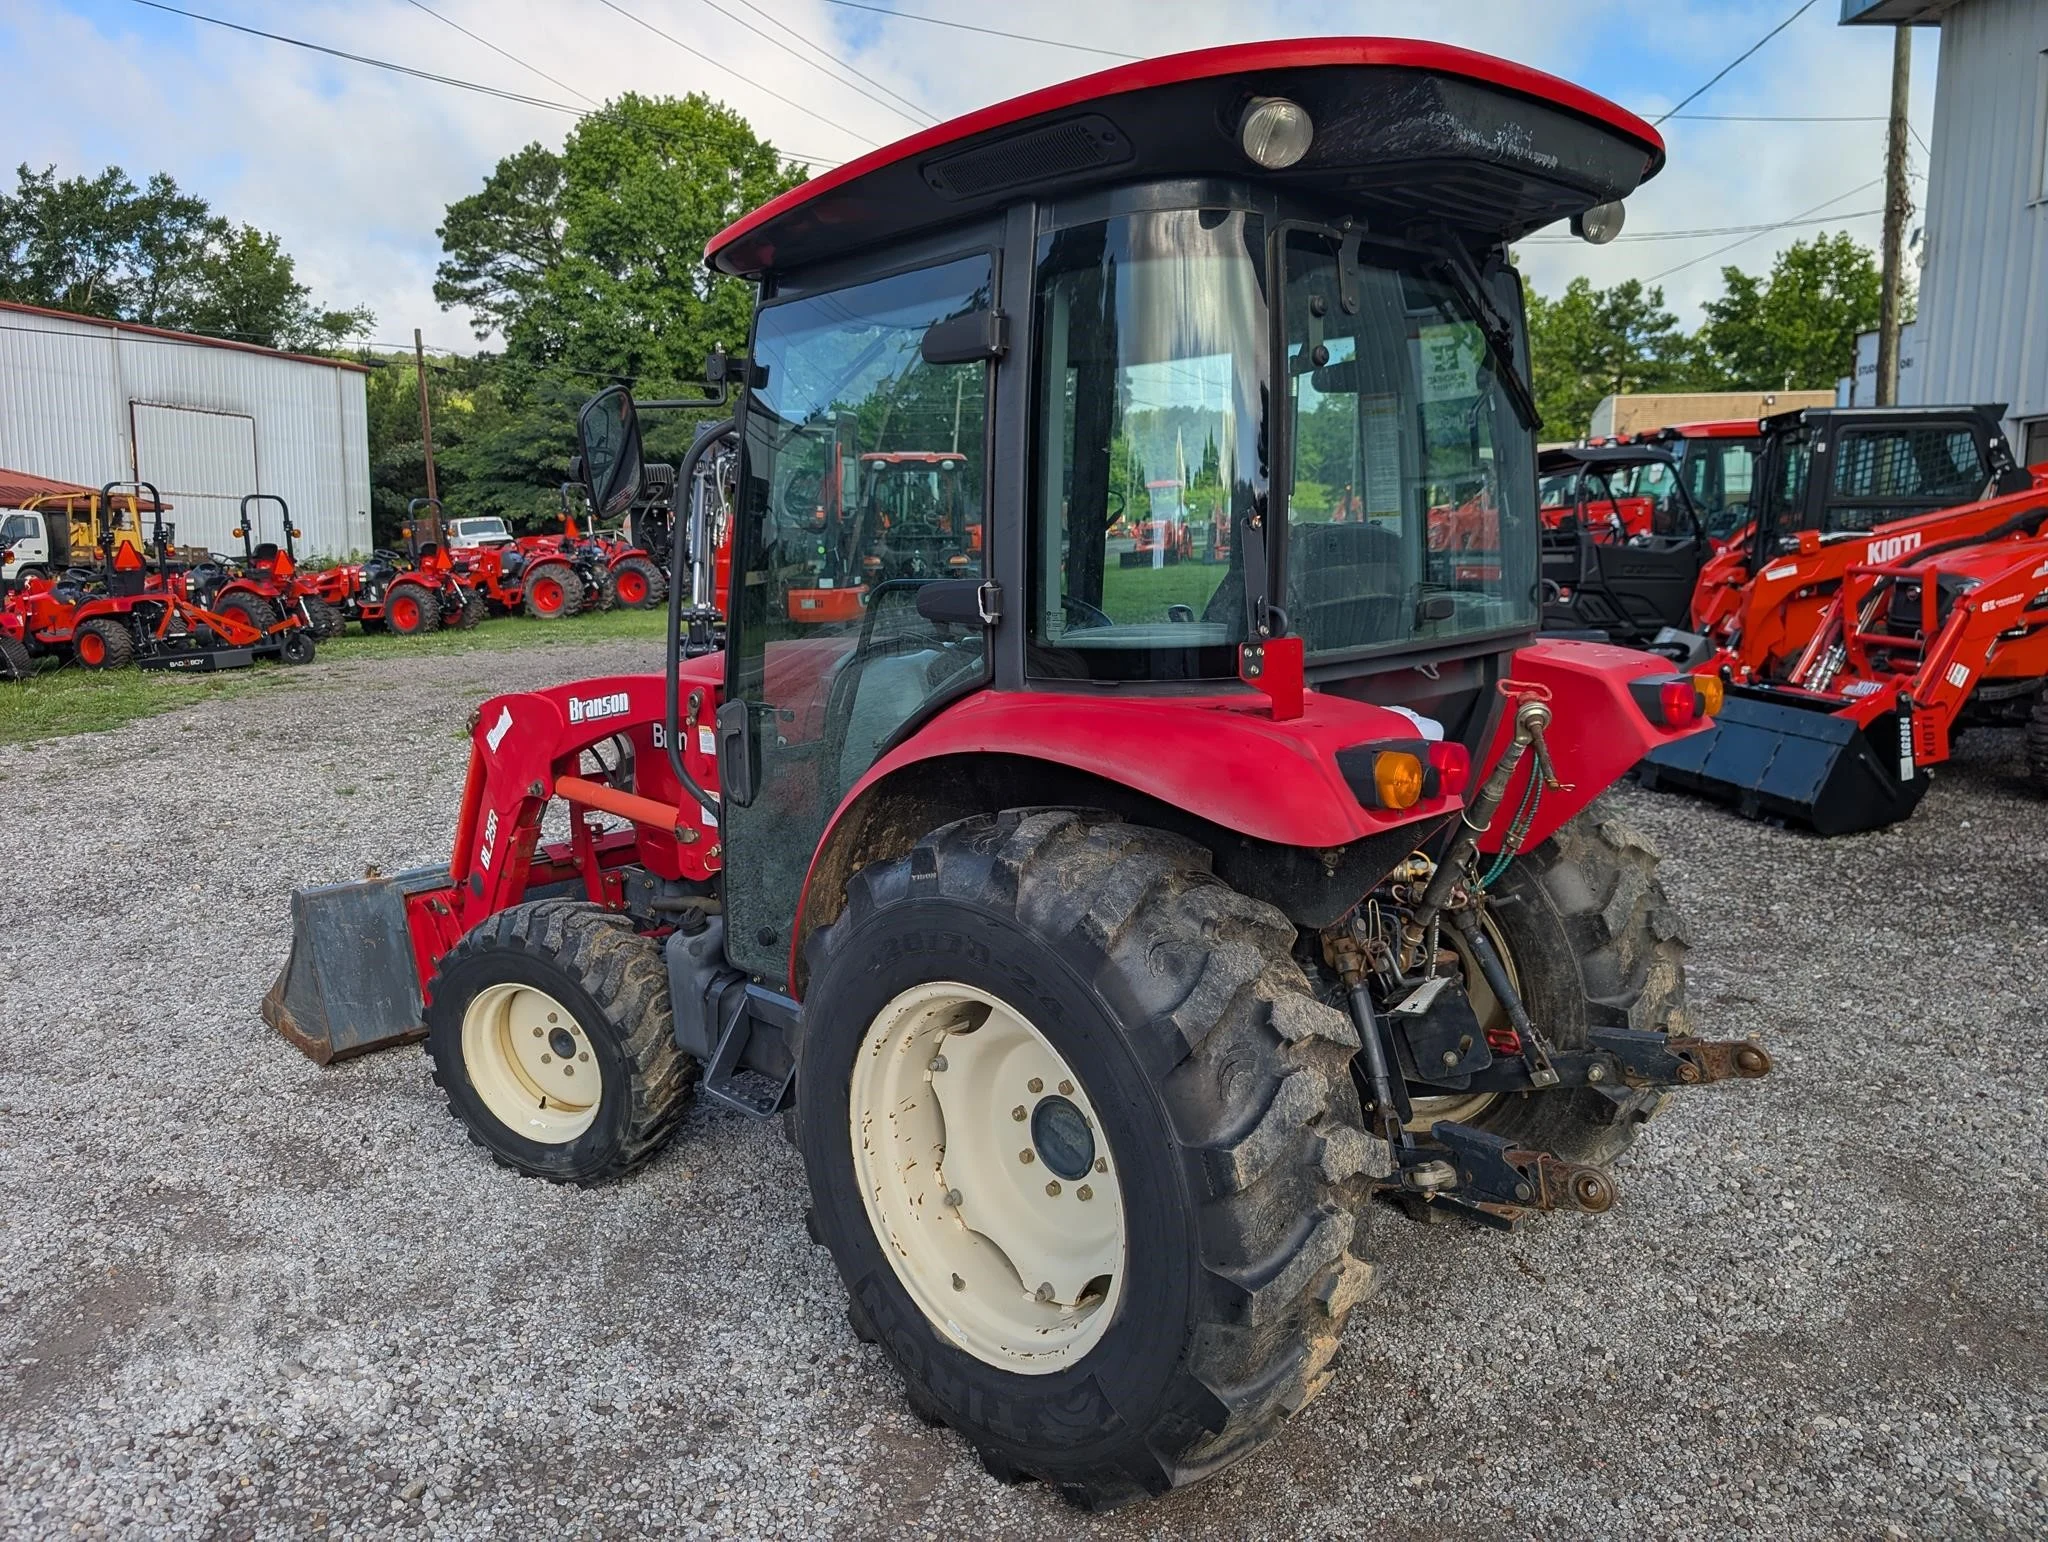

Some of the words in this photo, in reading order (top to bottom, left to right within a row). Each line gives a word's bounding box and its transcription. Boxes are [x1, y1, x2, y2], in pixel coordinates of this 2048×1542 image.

[1867, 531, 1921, 566] KIOTI
[569, 692, 629, 722] Branson
[1923, 716, 1936, 757] KIOTI
